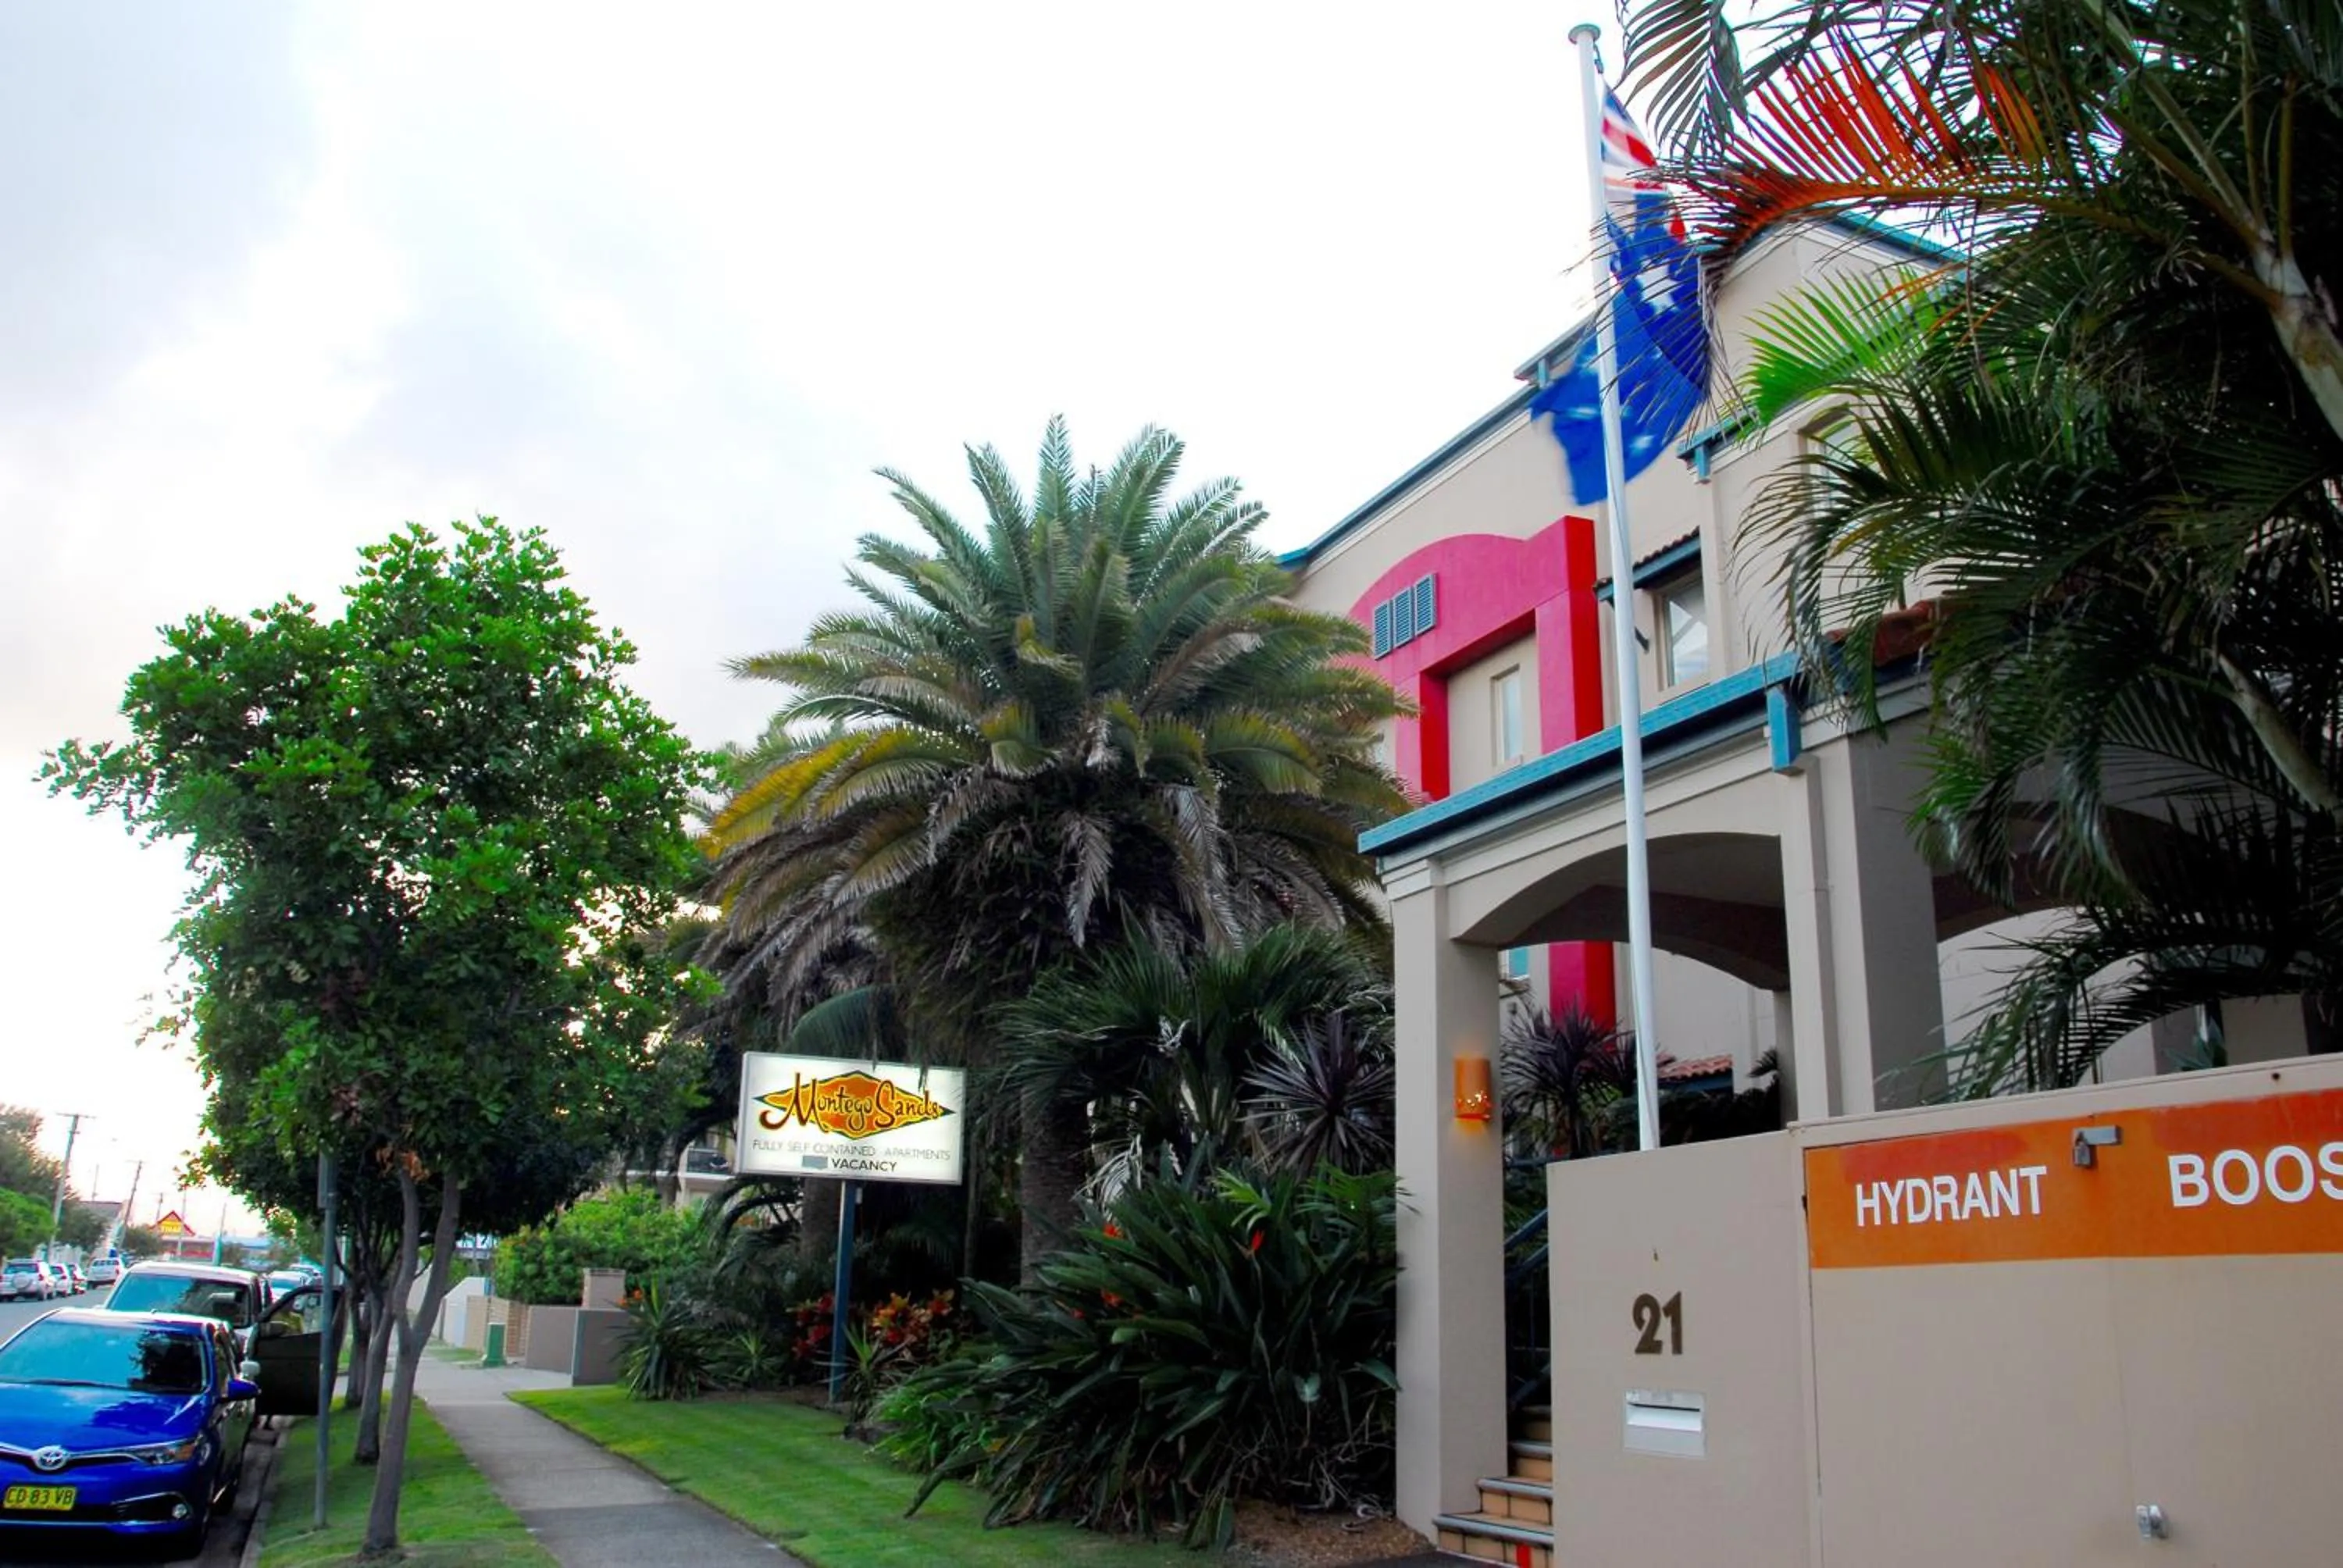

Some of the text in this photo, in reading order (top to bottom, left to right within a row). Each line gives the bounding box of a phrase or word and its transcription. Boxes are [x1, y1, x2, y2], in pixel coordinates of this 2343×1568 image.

[758, 1072, 939, 1132] Montego Sands
[752, 1139, 950, 1160] FULLY SELF CONTAINED APARTMENTS
[832, 1158, 897, 1171] VACANCY
[1855, 1141, 2343, 1227] HYDRANT BOOS
[1632, 1291, 1683, 1355] 21
